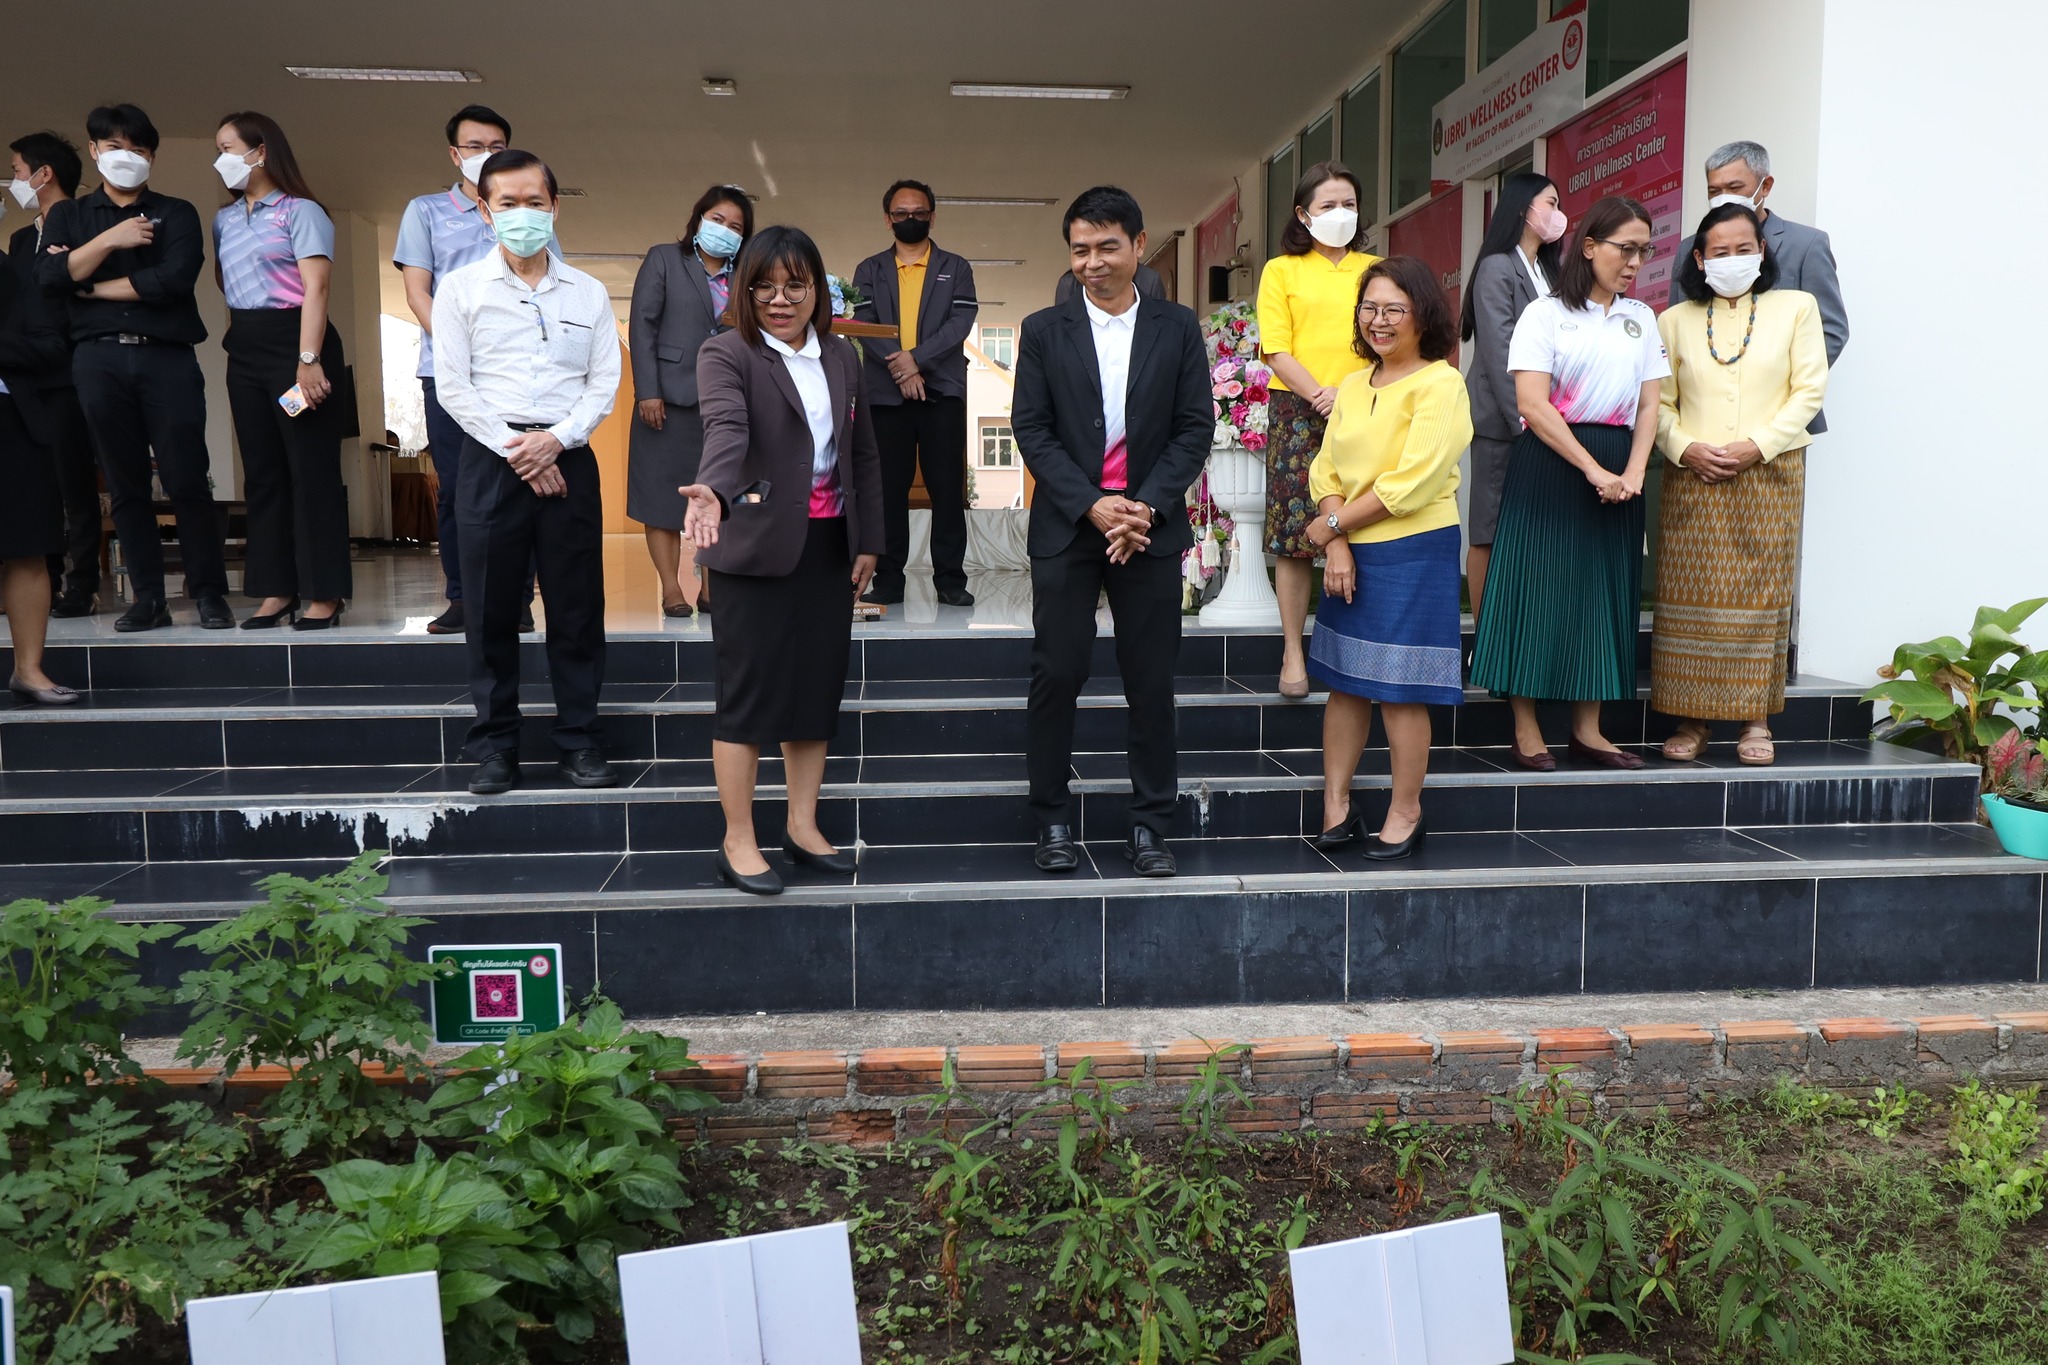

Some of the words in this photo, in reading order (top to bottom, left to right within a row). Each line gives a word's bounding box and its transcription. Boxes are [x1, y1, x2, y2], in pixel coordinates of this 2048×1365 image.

[1444, 117, 1467, 149] UBRU
[1469, 83, 1517, 130] WELLNESS
[1519, 53, 1559, 98] CENTER
[1465, 141, 1472, 153] BY
[1472, 131, 1490, 149] FACULTY
[1491, 125, 1498, 137] OF
[1498, 115, 1514, 133] PUBLIC
[1515, 102, 1533, 123] HEALTH
[1518, 118, 1544, 140] UNIVERSITY
[1568, 168, 1591, 194] UBRU
[1594, 151, 1633, 182] Wellness
[1636, 135, 1666, 162] Center
